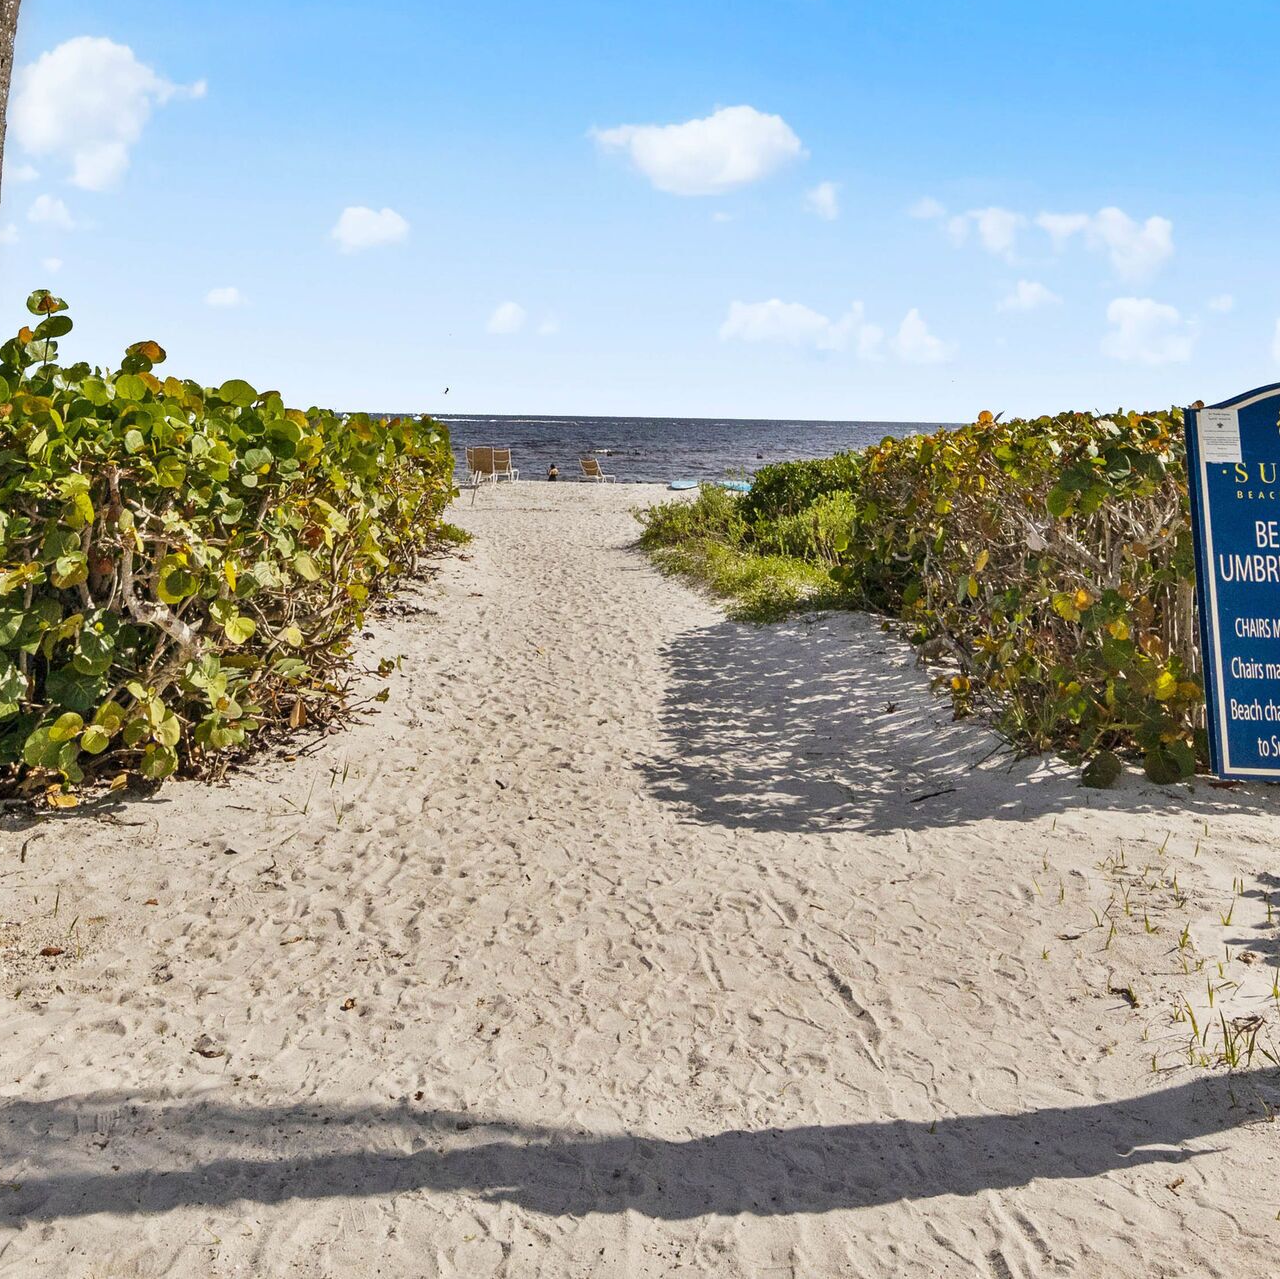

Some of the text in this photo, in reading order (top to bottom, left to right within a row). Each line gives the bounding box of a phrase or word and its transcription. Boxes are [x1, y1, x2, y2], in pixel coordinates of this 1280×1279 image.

[1234, 618, 1271, 638] CHAIRS
[1231, 656, 1264, 679] Chairs
[1230, 698, 1263, 721] Beach
[1258, 738, 1269, 756] to
